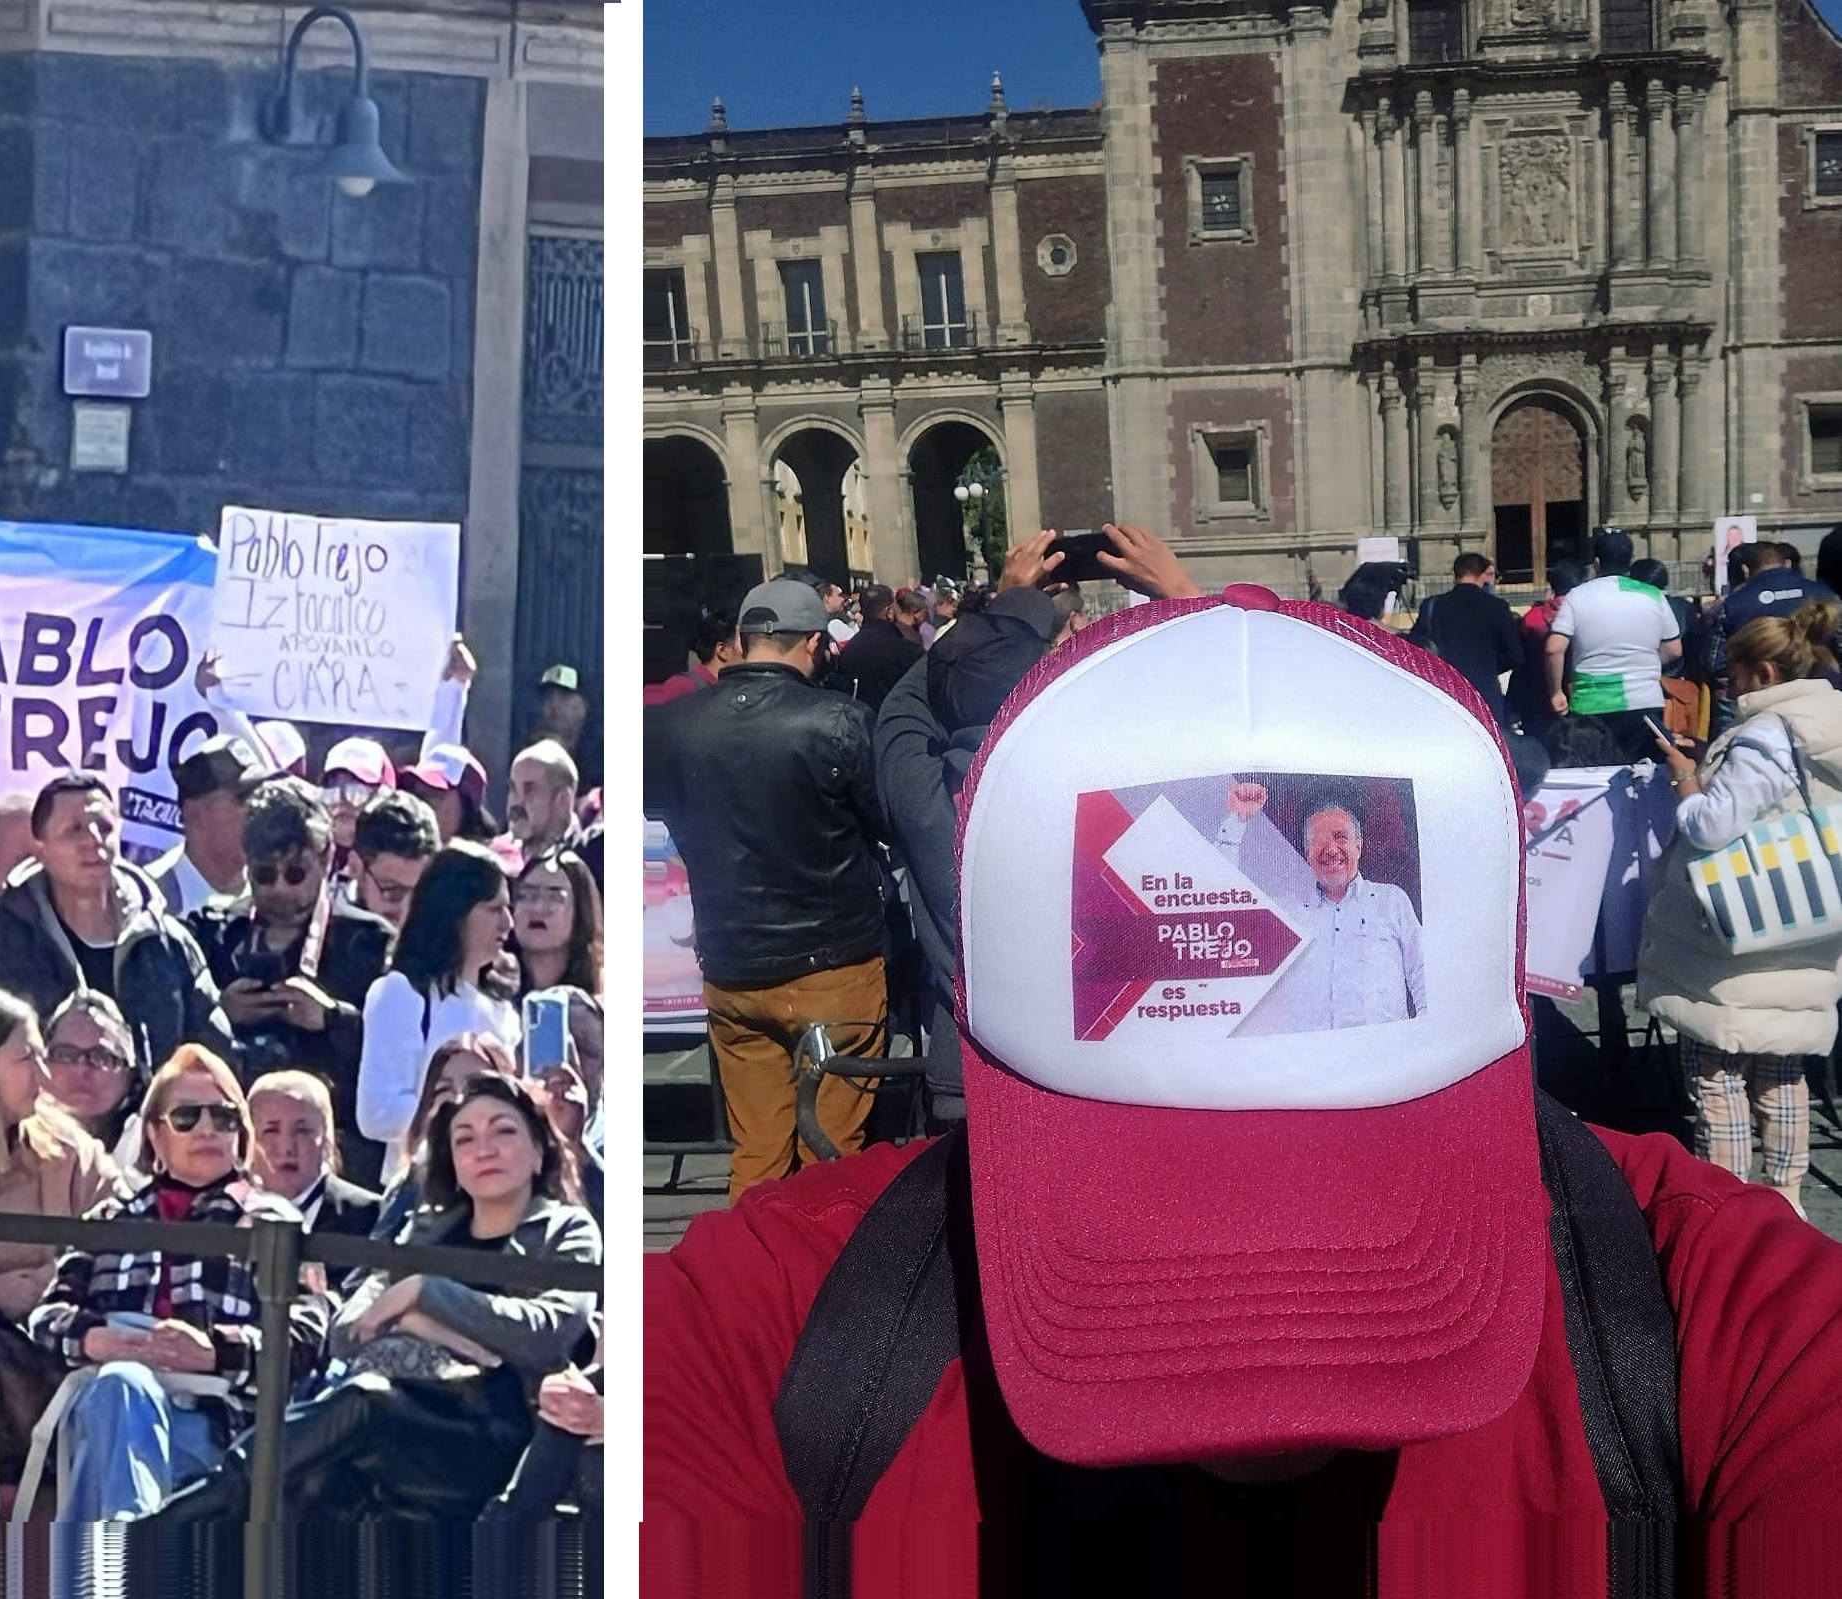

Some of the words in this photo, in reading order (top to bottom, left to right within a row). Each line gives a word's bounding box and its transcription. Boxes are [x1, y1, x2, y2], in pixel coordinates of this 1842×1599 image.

[226, 512, 305, 579] Pablo
[293, 518, 389, 596] Trejo
[1141, 874, 1168, 891] En
[1174, 872, 1193, 890] la
[1154, 888, 1258, 907] encuesta,
[1158, 921, 1235, 943] PABLO
[1172, 938, 1252, 961] TREJO
[1162, 985, 1186, 1000] es
[1137, 1000, 1242, 1021] respuesta
